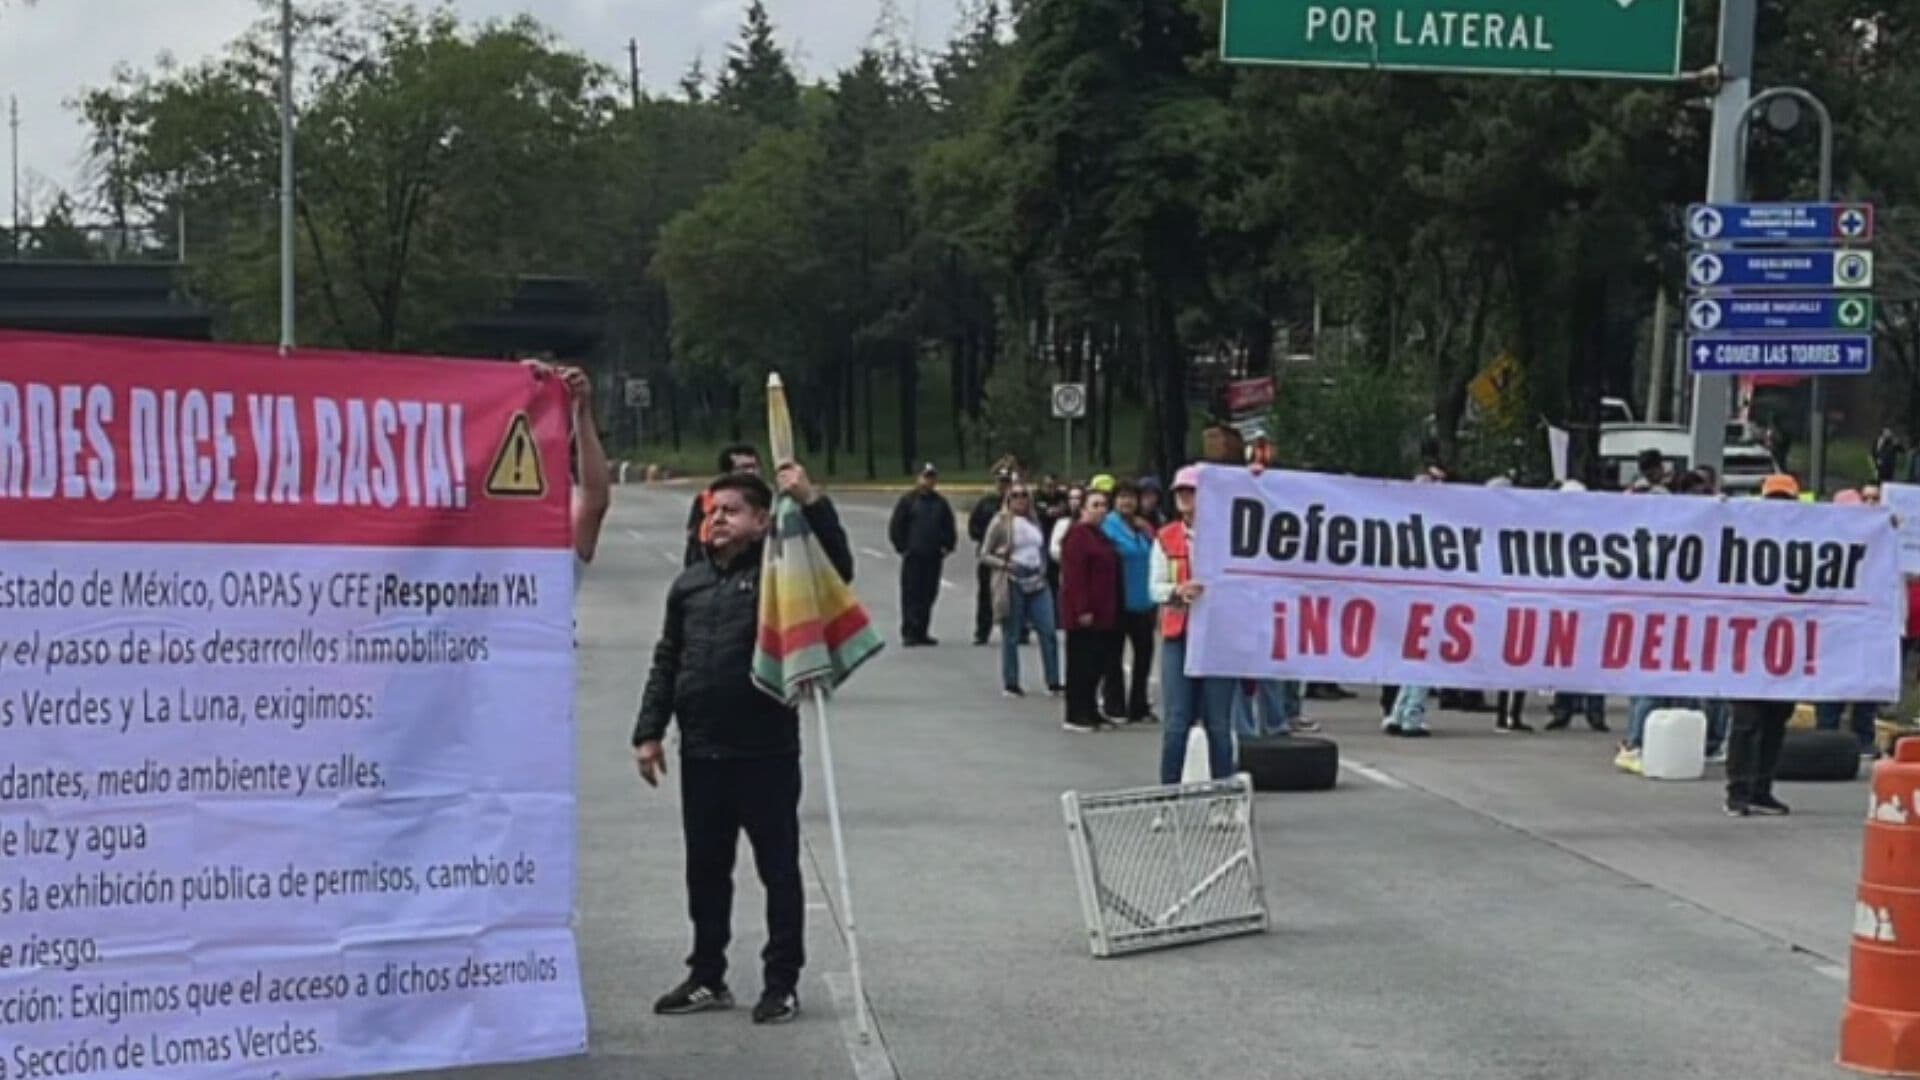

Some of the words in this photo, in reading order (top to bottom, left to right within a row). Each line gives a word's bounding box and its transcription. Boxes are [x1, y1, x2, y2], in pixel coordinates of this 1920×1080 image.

[1306, 6, 1376, 44] POR
[1394, 9, 1553, 50] LATERAL
[1764, 344, 1788, 364] LAS
[129, 388, 237, 503] DICE
[247, 393, 301, 503] YA
[313, 396, 467, 508] BASTA!
[1230, 497, 1483, 572] Defender
[1498, 527, 1704, 583] nuestro
[1717, 526, 1868, 594] hogar
[81, 568, 114, 607] de
[120, 567, 215, 612] México,
[219, 570, 302, 608] OAPAS
[308, 580, 323, 616] y
[327, 572, 372, 608] CFE
[503, 573, 538, 607] YA!
[13, 629, 41, 666] el
[45, 638, 112, 677] paso
[118, 629, 152, 665] de
[158, 629, 196, 666] los
[202, 629, 340, 665] desarrollos
[1271, 595, 1376, 662] ¡NO
[1402, 603, 1477, 664] ES
[1502, 607, 1579, 668] UN
[1600, 612, 1818, 678] DELITO!
[21, 687, 112, 727] Verdes
[118, 699, 134, 735] y
[143, 687, 171, 723] La
[180, 687, 247, 728] Luna,
[254, 686, 374, 731] exigimos:
[98, 758, 171, 796] medio
[176, 756, 292, 794] ambiente
[296, 763, 311, 798] y
[315, 753, 386, 790] calles.
[24, 817, 59, 855] luz
[65, 826, 80, 861] y
[85, 822, 147, 861] agua
[19, 876, 39, 913] la
[45, 869, 175, 911] exhibición
[181, 865, 271, 911] pública
[278, 861, 309, 898] de
[314, 860, 420, 904] permisos,
[426, 854, 510, 891] cambio
[513, 851, 536, 886] de
[18, 932, 104, 972] riesgo.
[0, 986, 64, 1025] ción:
[71, 980, 182, 1025] Exigimos
[185, 979, 234, 1016] que
[239, 969, 263, 1004] el
[268, 971, 350, 1004] acceso
[354, 971, 369, 998] a
[375, 960, 451, 998] dichos
[13, 1038, 106, 1080] Sección
[112, 1033, 146, 1070] de
[152, 1032, 232, 1067] Lomas
[235, 1020, 325, 1058] Verdes.
